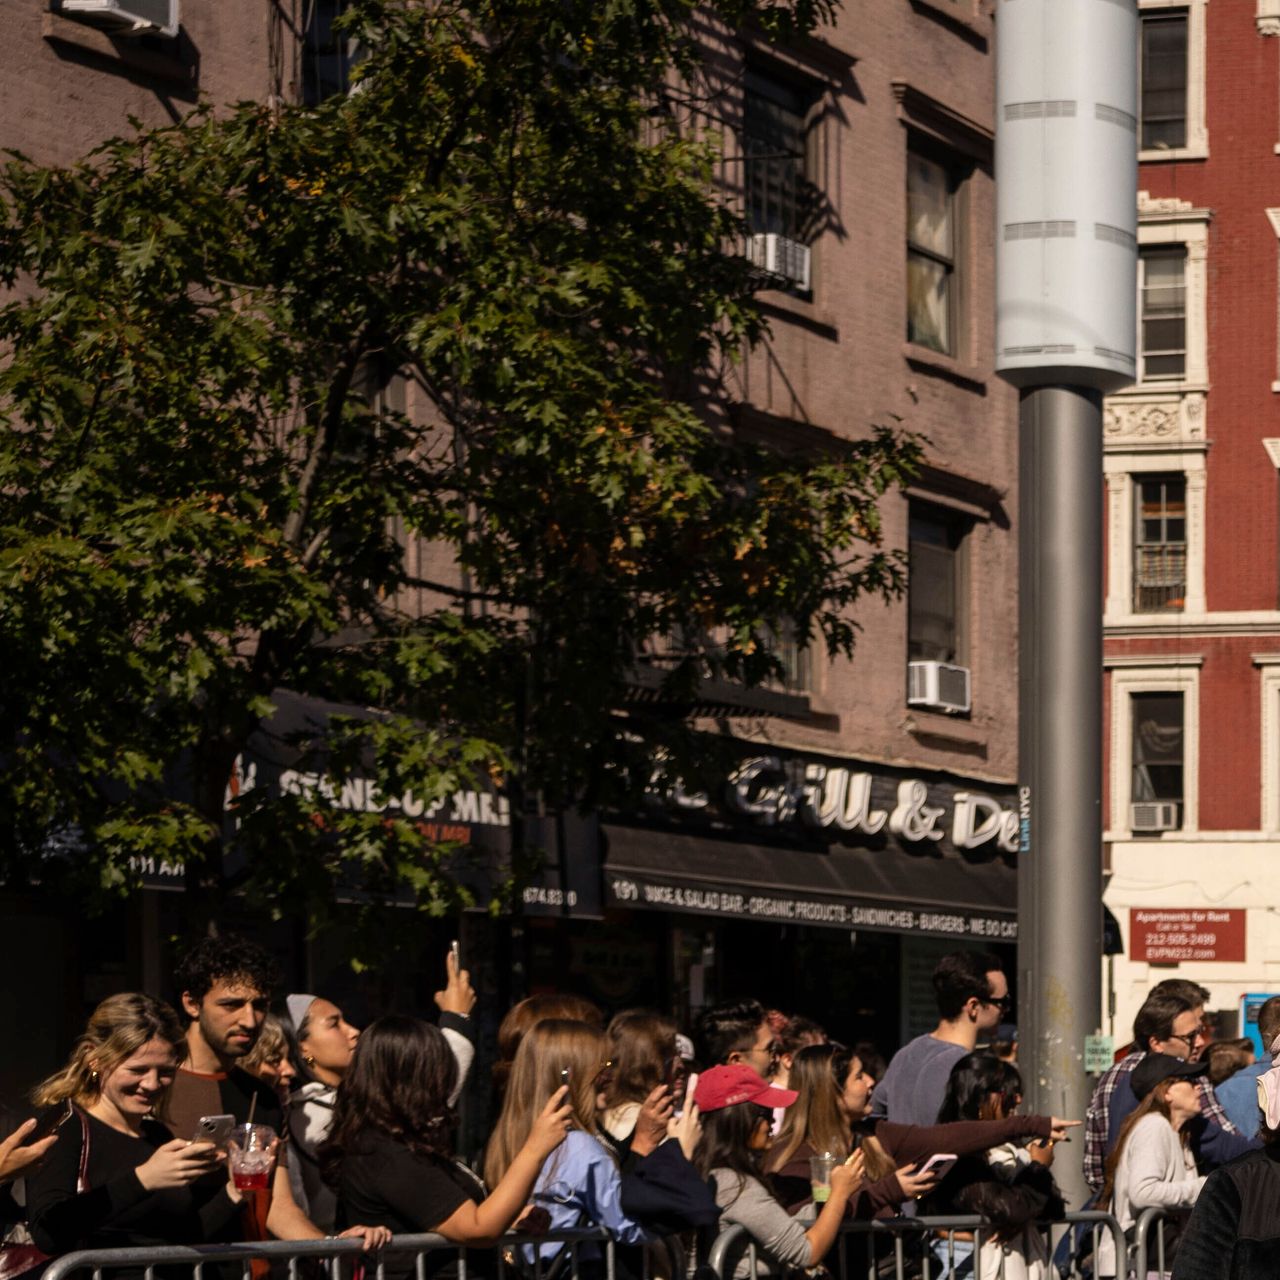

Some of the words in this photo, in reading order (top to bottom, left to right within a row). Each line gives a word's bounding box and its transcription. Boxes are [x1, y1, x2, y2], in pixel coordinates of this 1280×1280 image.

[889, 779, 946, 842] &
[684, 887, 720, 911] SALAD
[720, 893, 744, 913] BAR
[749, 895, 796, 919] ORGANIC
[796, 901, 847, 923] PRODUCTS
[919, 912, 965, 933] BURGERS
[1136, 911, 1191, 924] Apartments
